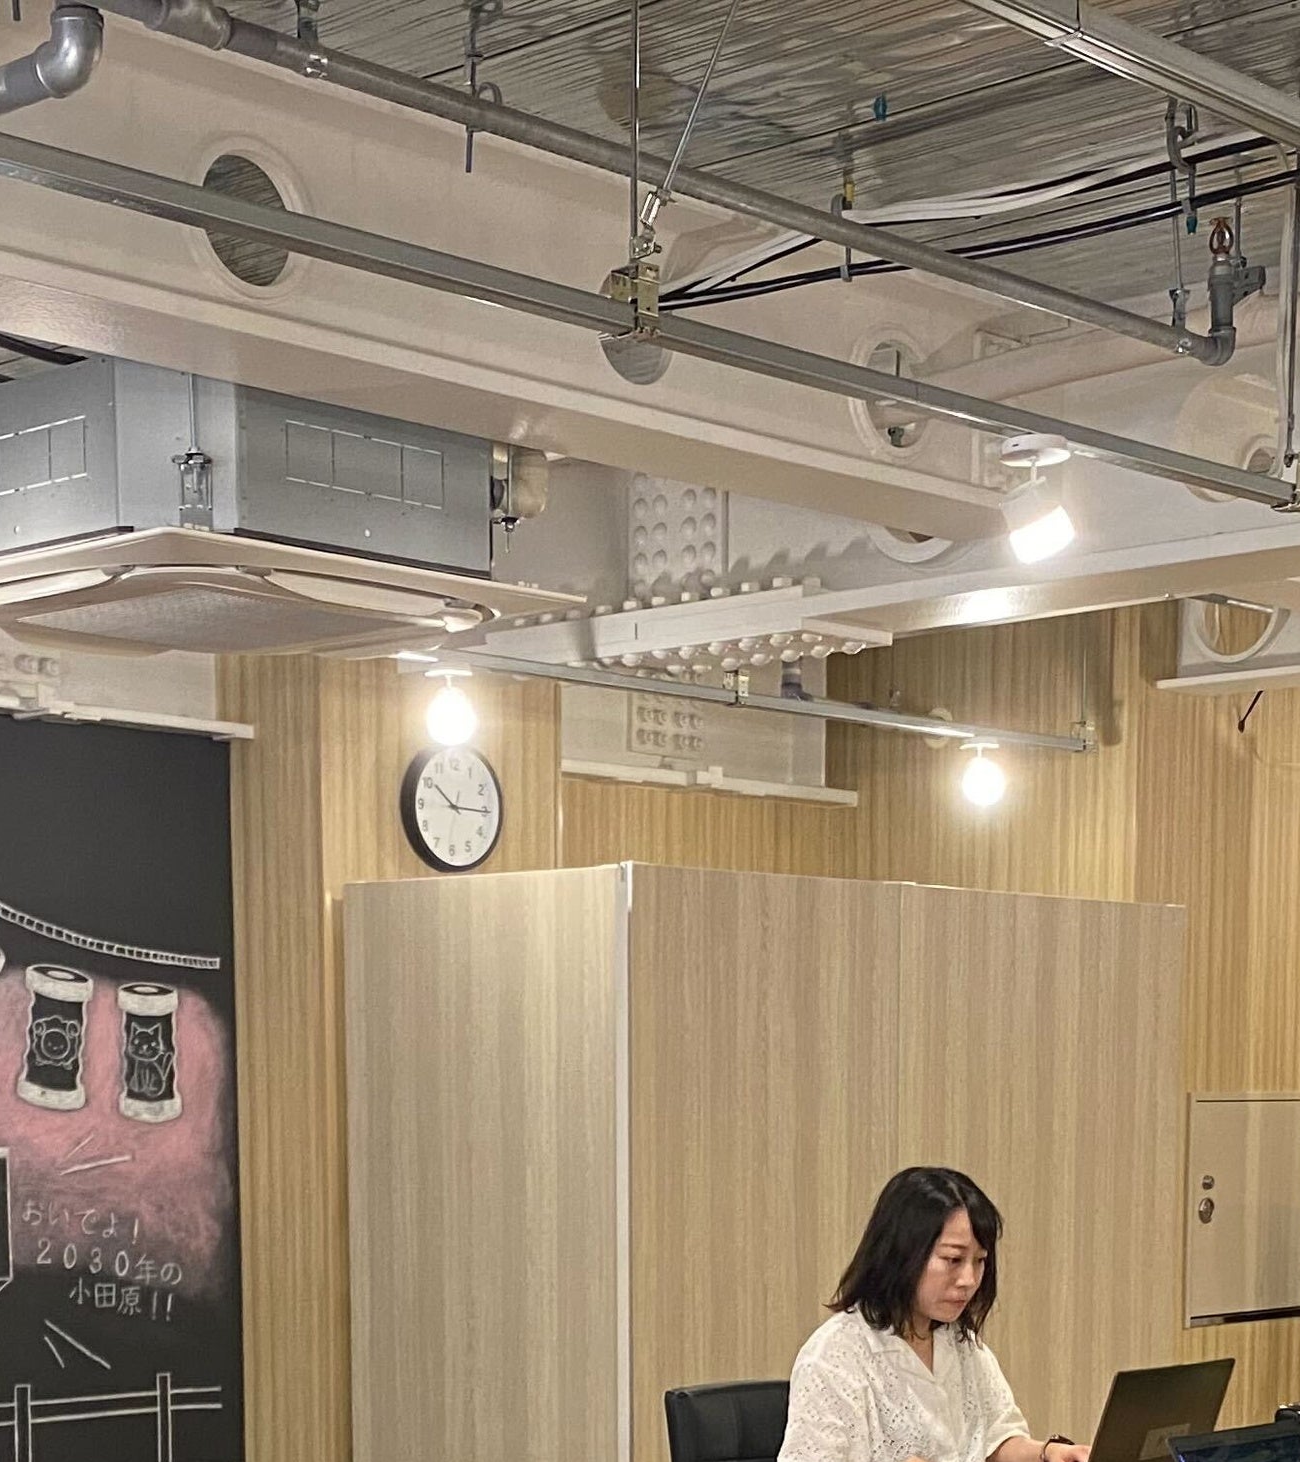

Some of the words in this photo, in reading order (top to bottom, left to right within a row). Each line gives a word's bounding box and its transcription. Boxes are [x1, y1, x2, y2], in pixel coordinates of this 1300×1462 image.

[422, 777, 434, 789] 10
[477, 783, 485, 797] 2
[417, 797, 425, 810] 9
[448, 844, 456, 857] 6
[464, 840, 472, 853] 5
[36, 1238, 183, 1285] 2030年の
